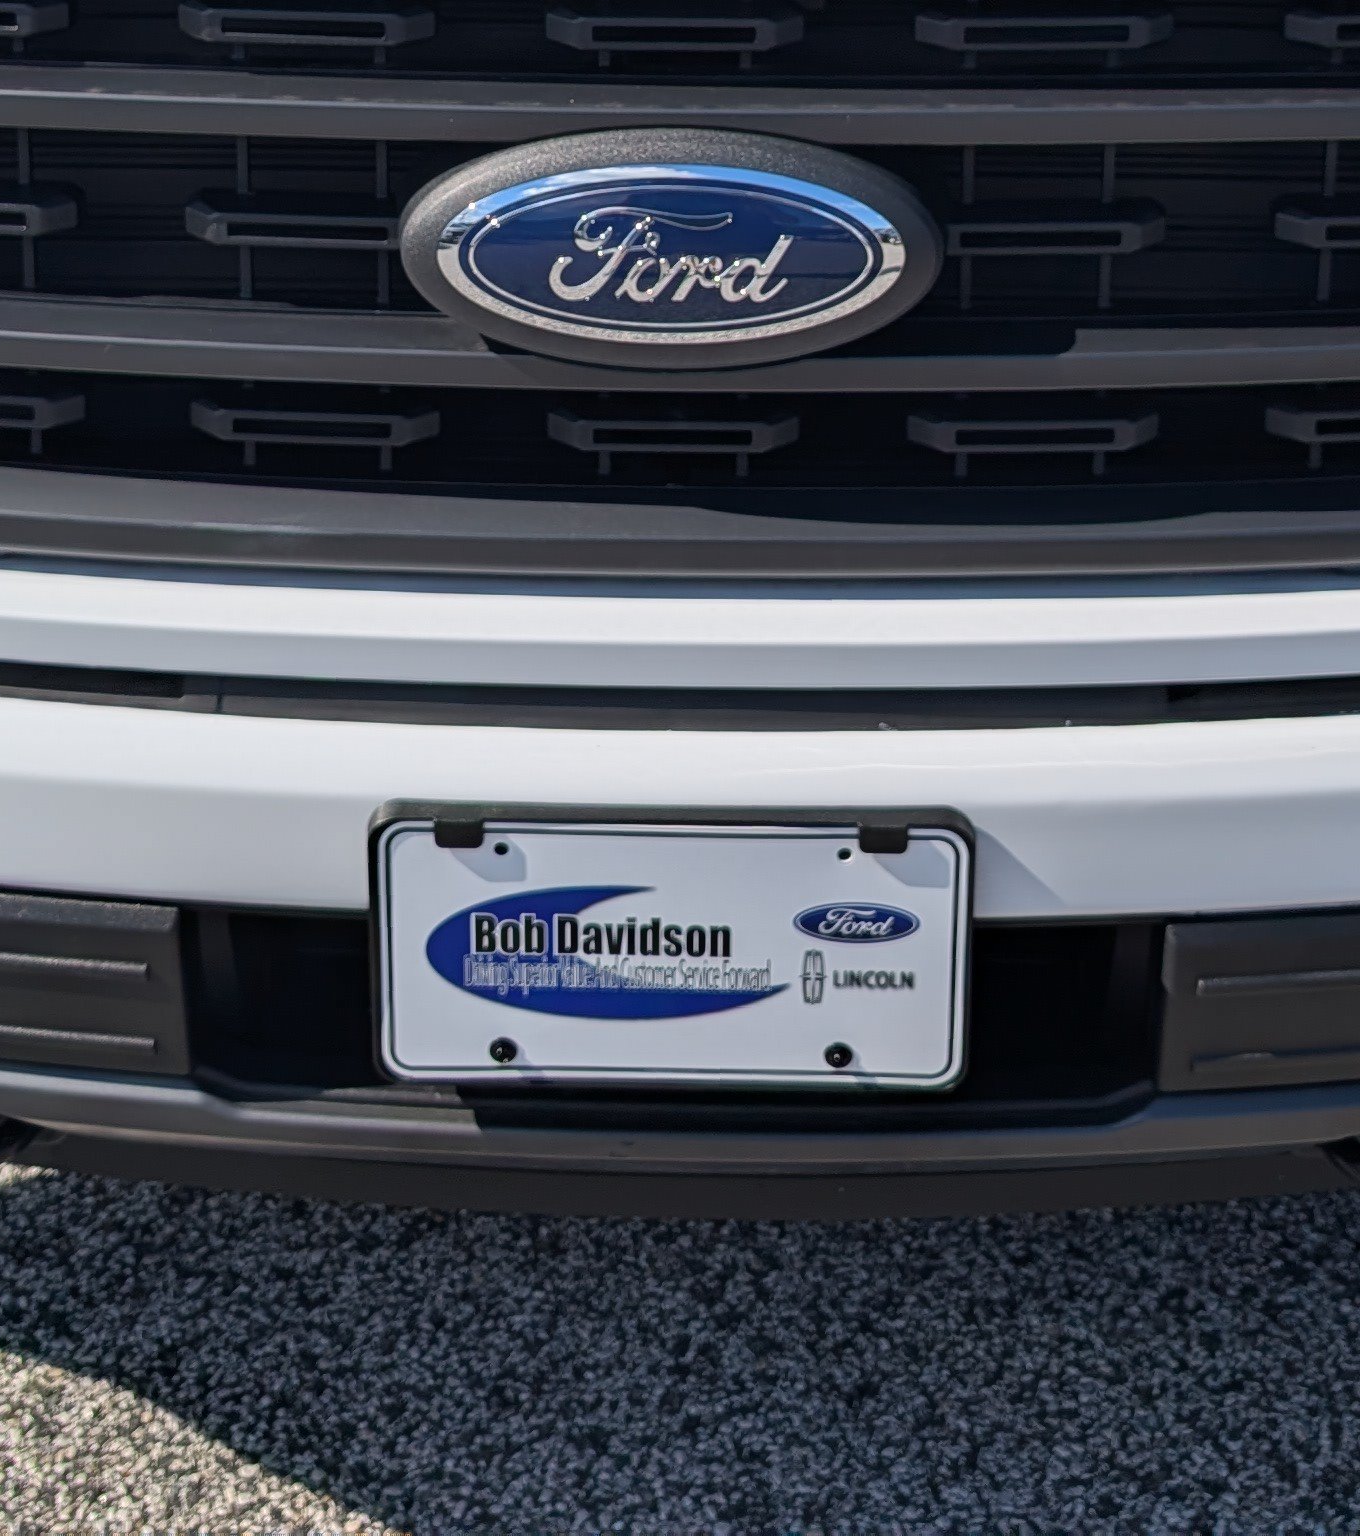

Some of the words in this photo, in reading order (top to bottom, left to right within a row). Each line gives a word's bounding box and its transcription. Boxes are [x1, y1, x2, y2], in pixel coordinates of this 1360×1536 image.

[548, 206, 795, 302] Ford
[473, 913, 546, 955] Bob
[556, 914, 731, 957] Davidson
[818, 908, 895, 936] Ford
[832, 969, 915, 990] LINCOLN
